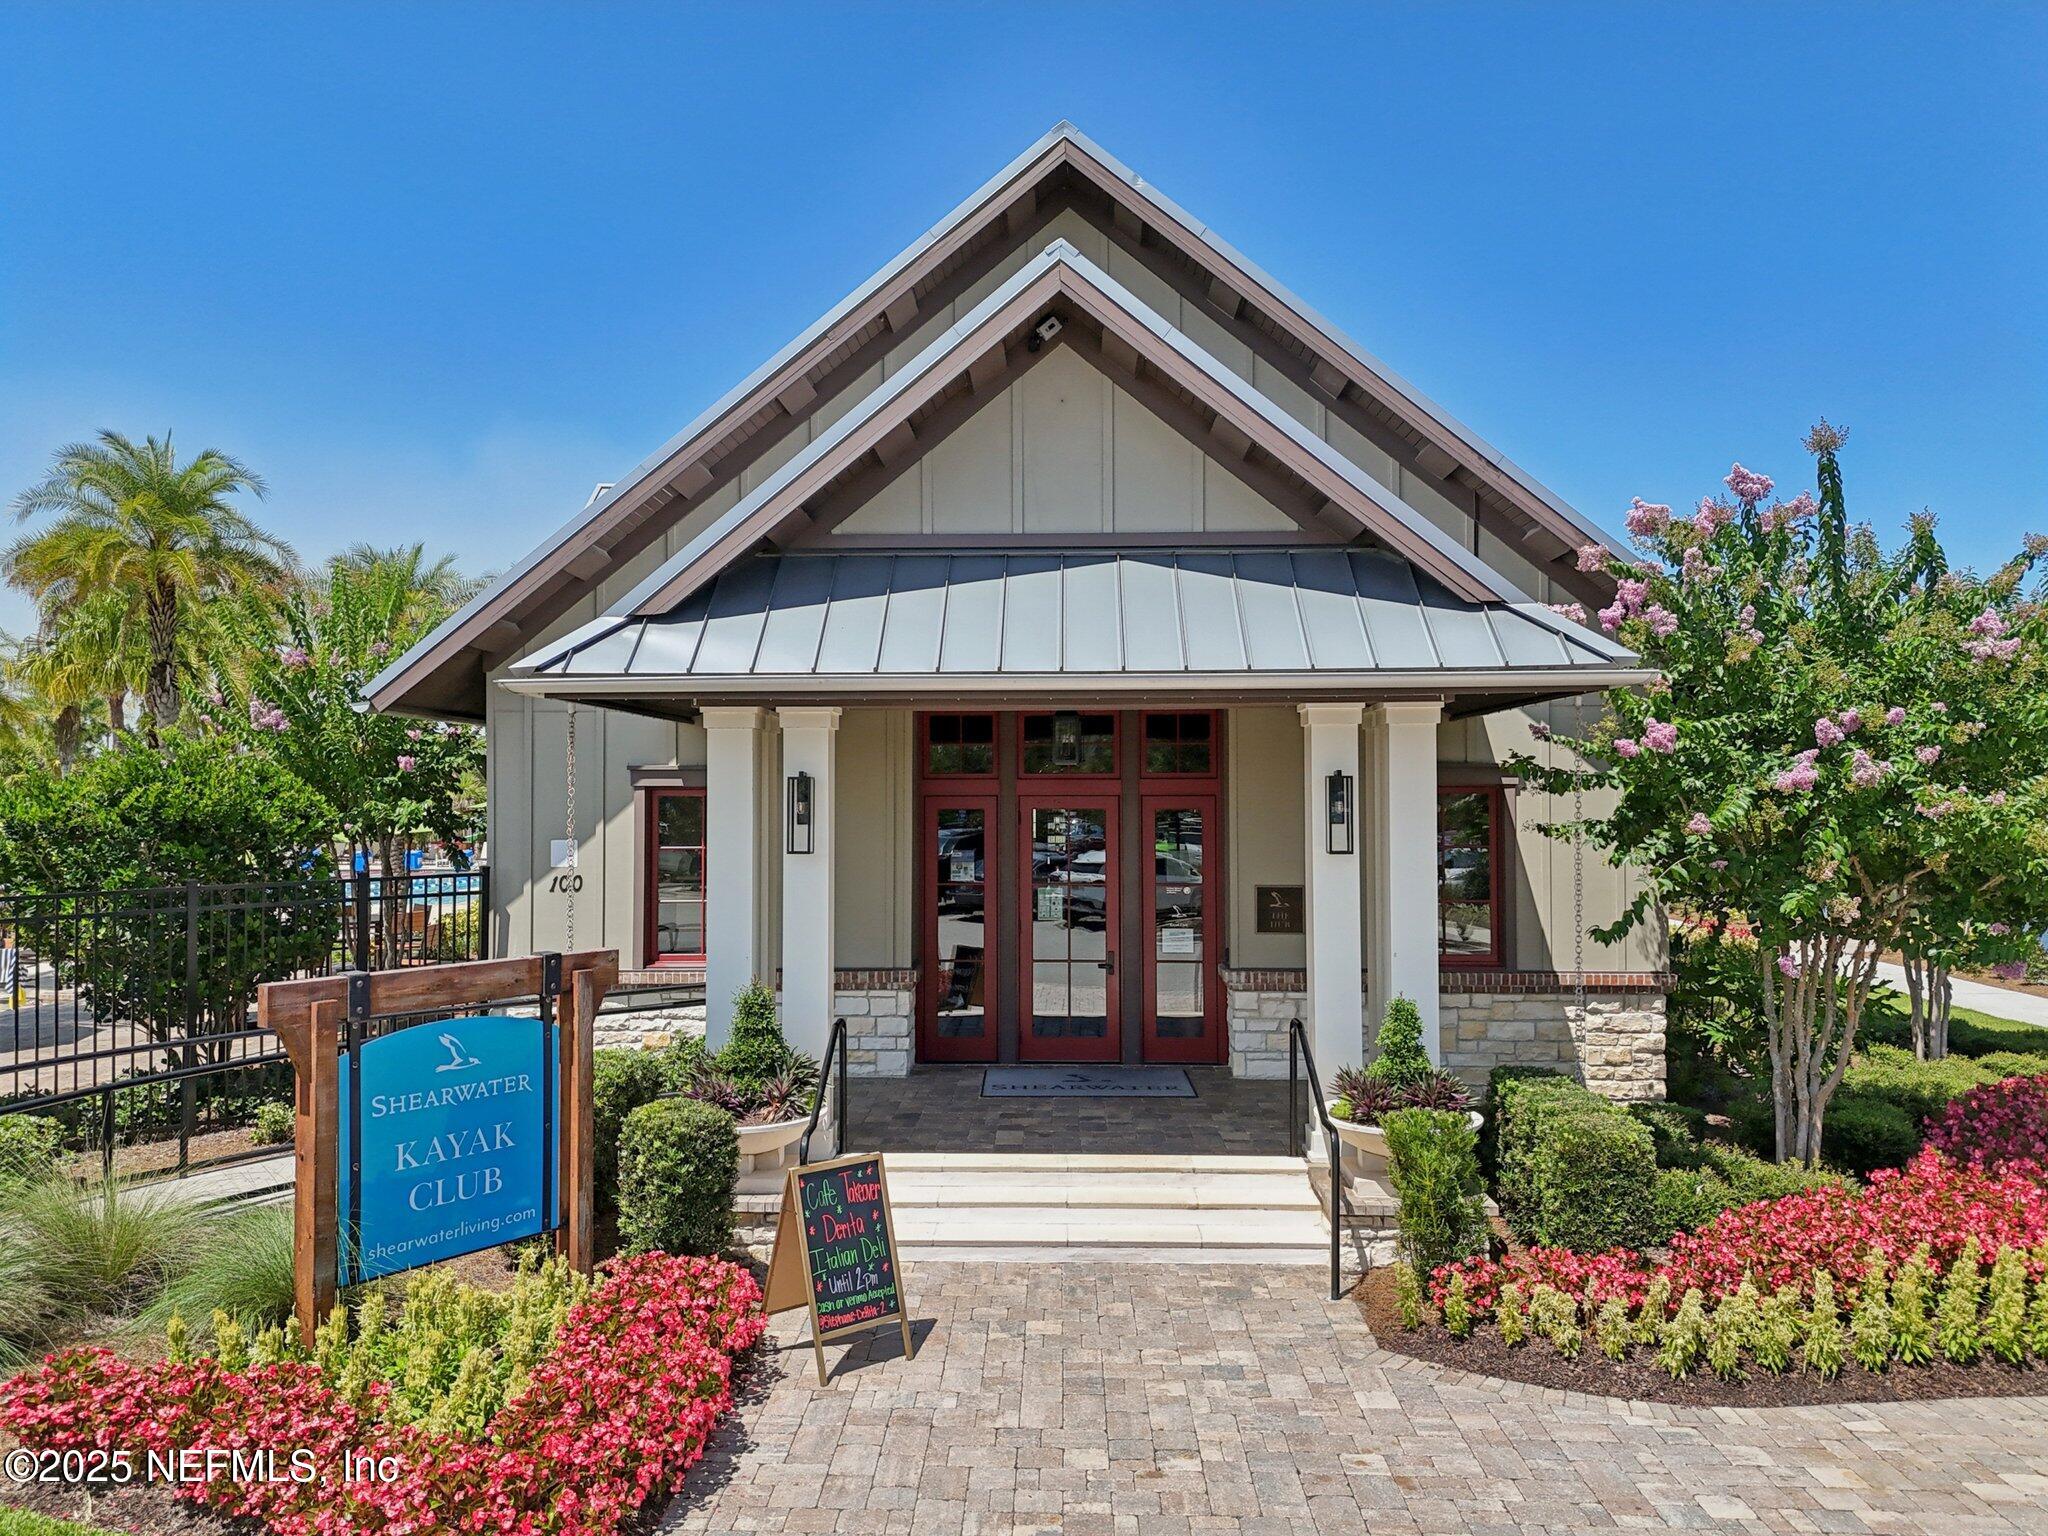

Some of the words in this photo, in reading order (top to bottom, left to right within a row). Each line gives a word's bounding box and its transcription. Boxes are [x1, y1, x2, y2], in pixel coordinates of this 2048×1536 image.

[549, 875, 583, 893] 100
[371, 1074, 533, 1117] SHEARWATER
[991, 1084, 1183, 1092] SHEARWATER
[394, 1121, 516, 1172] KAYAK
[409, 1167, 503, 1211] CLUB
[806, 1179, 837, 1210] Cafe
[838, 1171, 880, 1203] Takeover
[368, 1208, 536, 1261] shearwaterliving.com
[809, 1246, 859, 1276] Italian
[860, 1236, 886, 1263] Deli
[828, 1271, 853, 1294] Until
